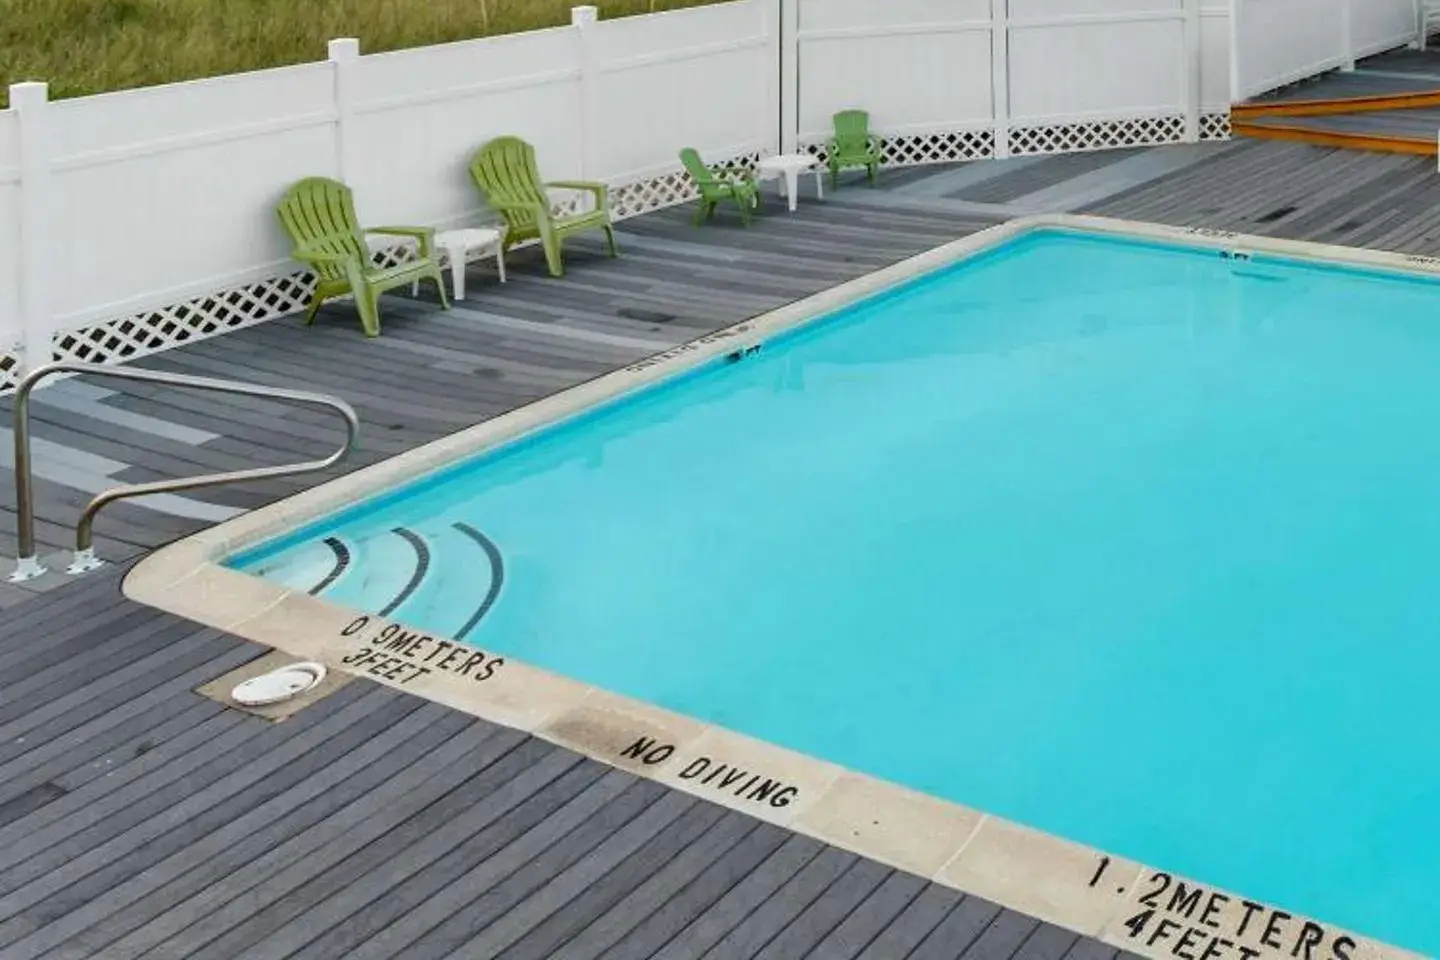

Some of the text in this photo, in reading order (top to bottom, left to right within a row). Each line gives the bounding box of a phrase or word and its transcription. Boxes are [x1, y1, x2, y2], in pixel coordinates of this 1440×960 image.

[342, 647, 432, 686] 3FEET
[621, 736, 799, 808] NO DIVING
